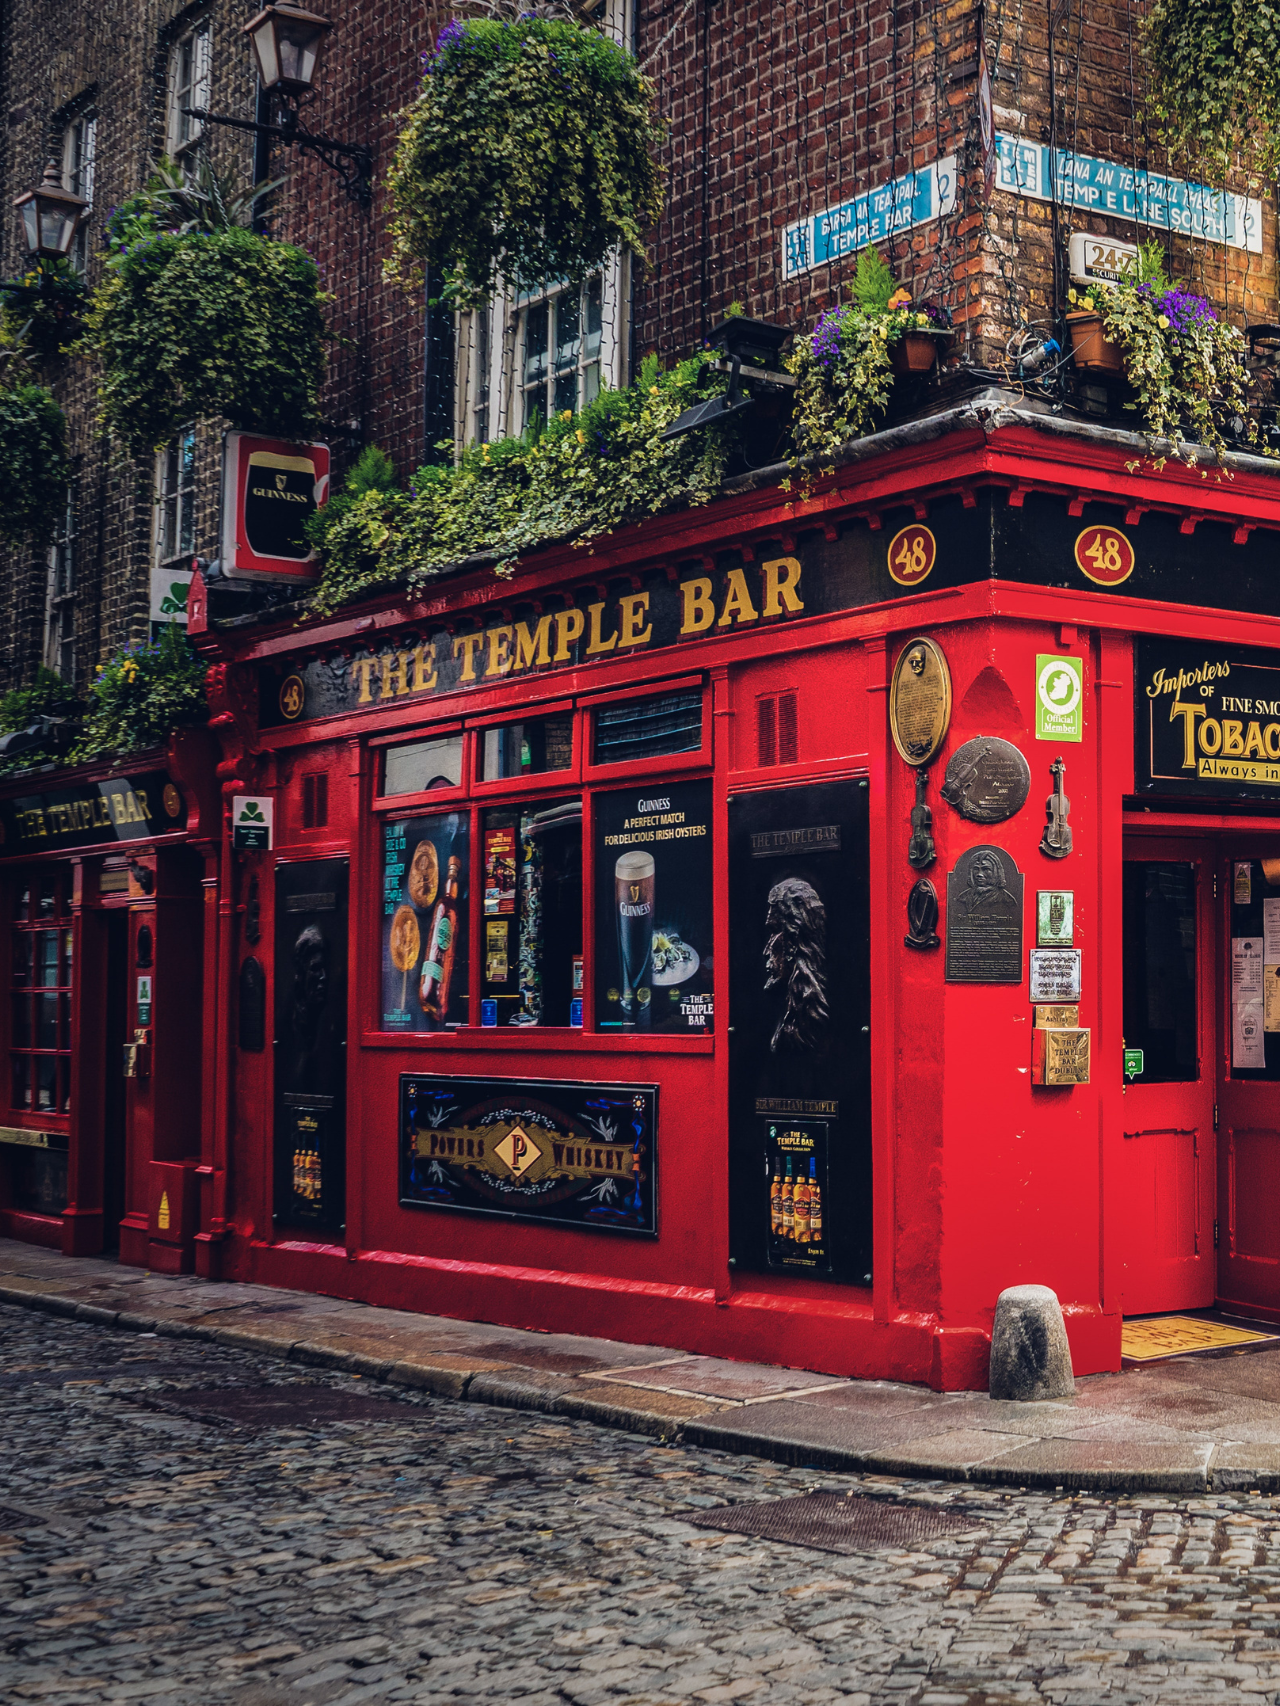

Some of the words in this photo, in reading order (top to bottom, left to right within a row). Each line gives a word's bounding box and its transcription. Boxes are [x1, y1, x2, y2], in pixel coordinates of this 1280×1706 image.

[1059, 158, 1090, 181] LANA
[1095, 167, 1114, 186] AN
[938, 174, 950, 201] 2
[1171, 208, 1224, 236] SOUTH
[832, 219, 880, 252] TEMPLE
[1092, 268, 1121, 281] SECURIT
[252, 487, 308, 503] GUINNESS
[894, 538, 928, 576] 48
[1087, 538, 1123, 573] 48
[353, 650, 438, 703] THE
[453, 592, 652, 684] TEMPLE
[679, 556, 804, 635] BAR
[1146, 660, 1230, 701] Importers
[284, 685, 299, 711] 48
[1200, 685, 1214, 698] OF
[1221, 696, 1252, 714] FINE
[1044, 723, 1076, 733] Member
[1047, 714, 1073, 724] Official
[1201, 762, 1257, 779] Always
[1265, 765, 1279, 780] in
[15, 808, 48, 838] THE
[48, 797, 111, 834] TEMPLE
[111, 789, 152, 825] BAR
[638, 798, 670, 812] GUINNESS
[624, 819, 630, 829] A
[631, 815, 660, 828] PERFECT
[661, 812, 685, 825] MATCH
[605, 836, 618, 846] FOR
[619, 831, 654, 844] DELICIOUS
[656, 828, 675, 840] IRISH
[675, 825, 707, 838] OYSTERS
[751, 835, 770, 847] THE
[773, 829, 814, 846] TEMPLE
[816, 827, 838, 841] BAR
[620, 902, 651, 916] GUINNESS
[690, 995, 704, 1004] THE
[680, 1003, 714, 1015] TEMPLE
[688, 1015, 706, 1026] BAR
[768, 1100, 803, 1111] WILLIAM
[804, 1101, 837, 1112] TEMPLE
[777, 1137, 800, 1146] TEMPLE
[801, 1138, 815, 1147] BAR
[429, 1133, 484, 1159] POWERS
[552, 1143, 625, 1171] WHISKEY
[511, 1133, 529, 1171] P
